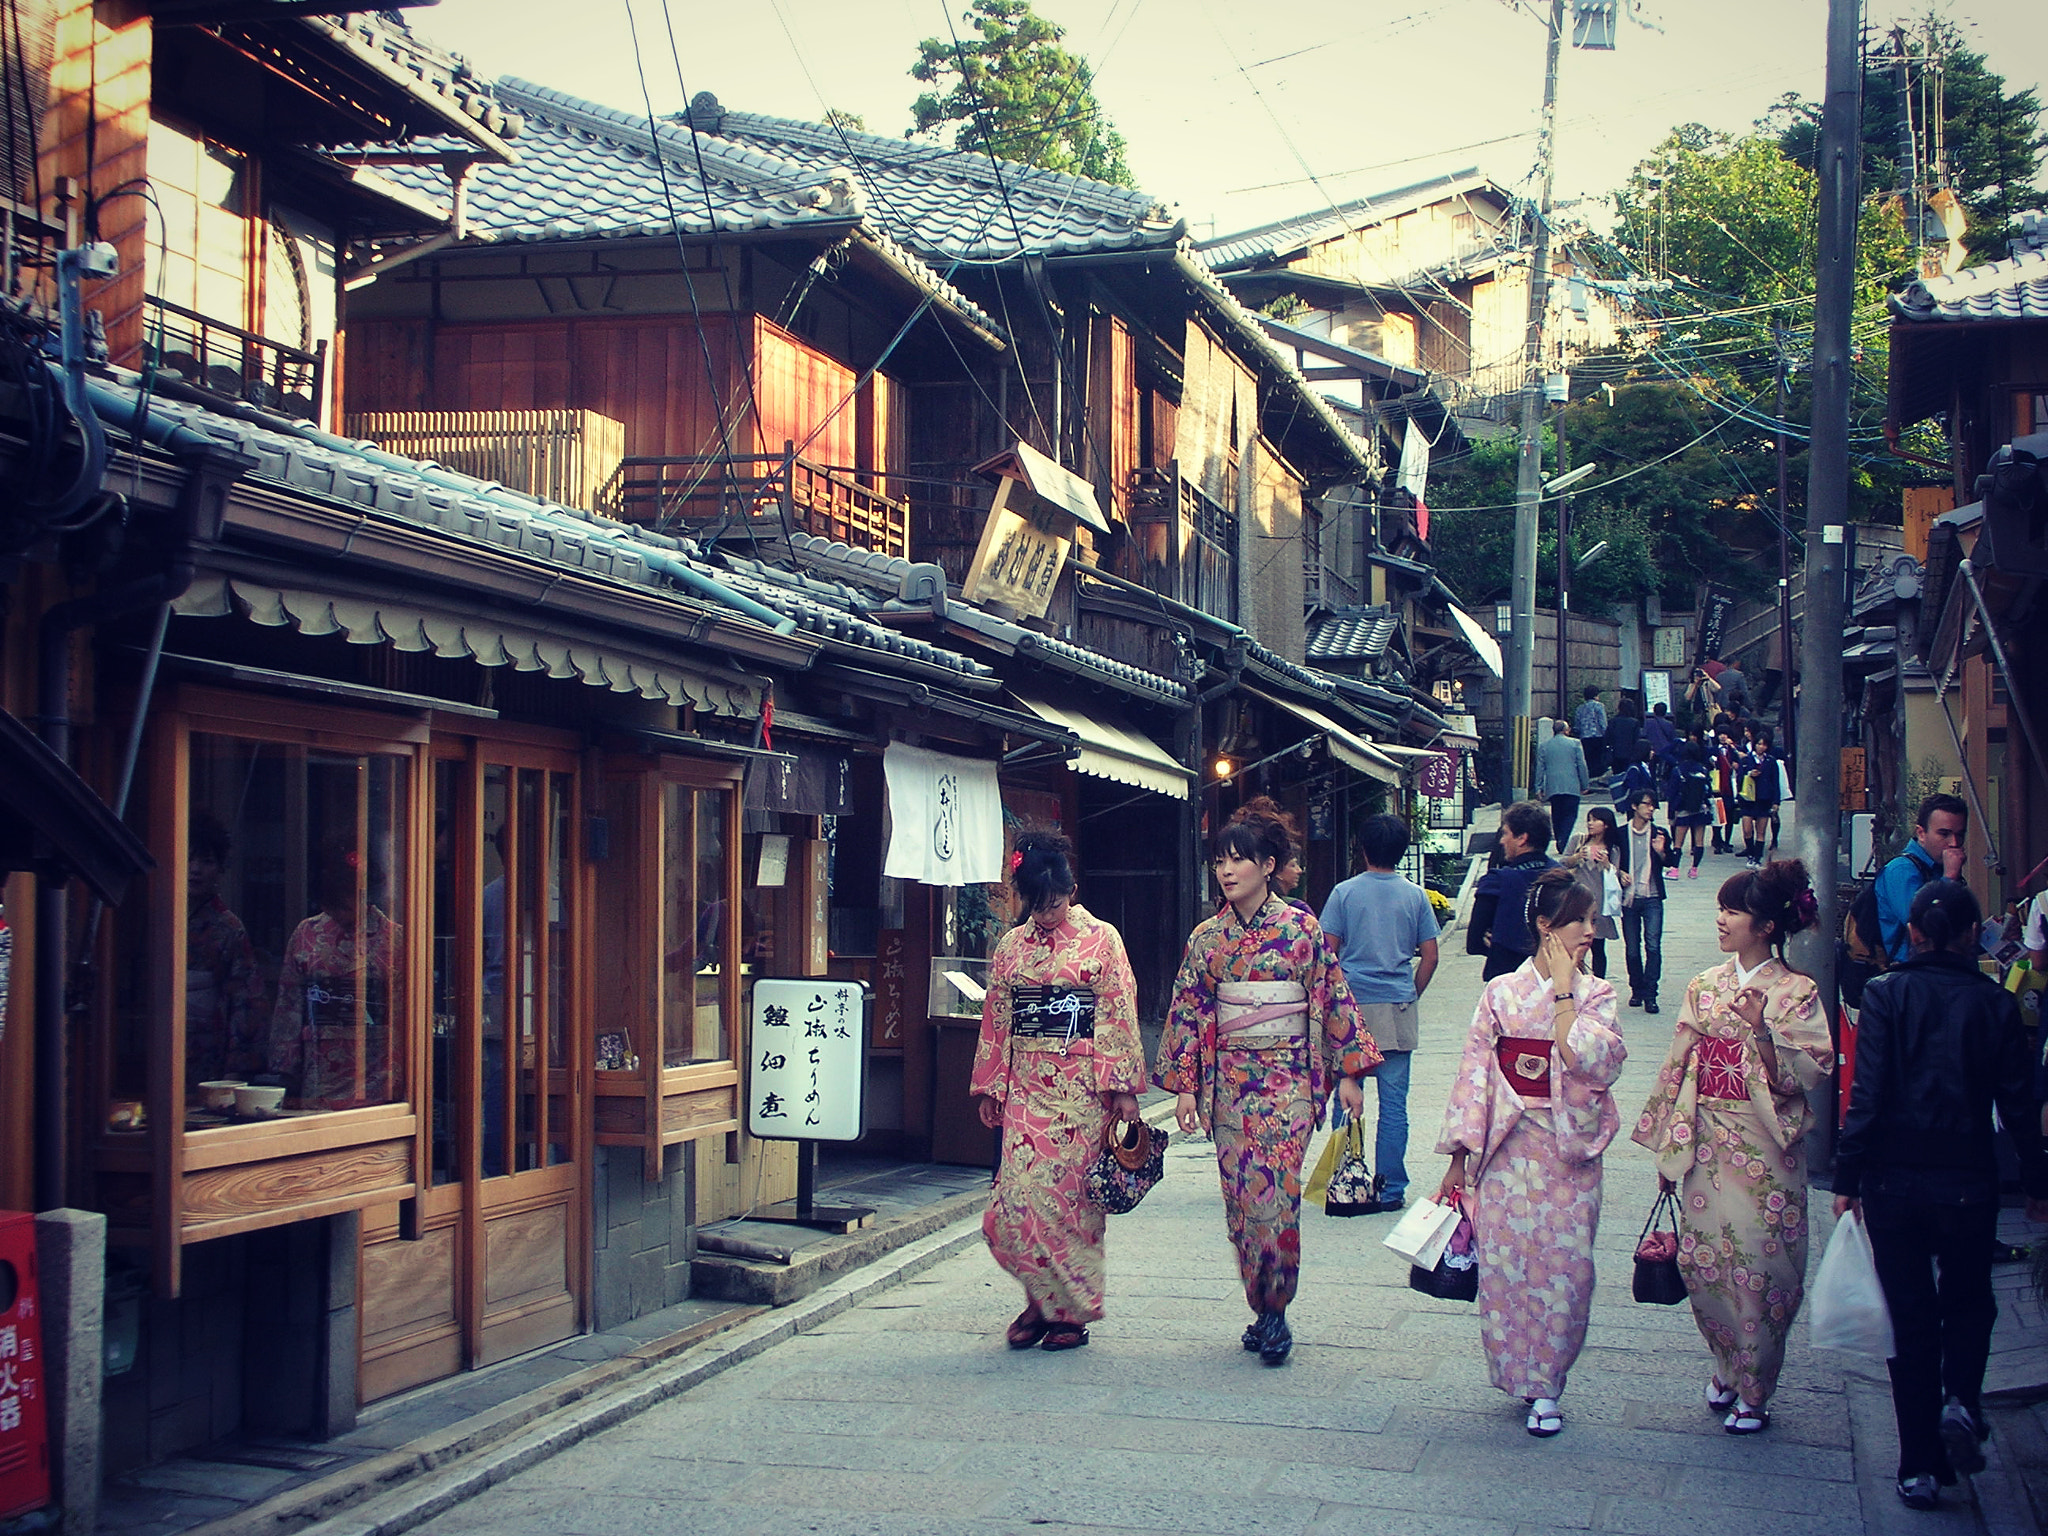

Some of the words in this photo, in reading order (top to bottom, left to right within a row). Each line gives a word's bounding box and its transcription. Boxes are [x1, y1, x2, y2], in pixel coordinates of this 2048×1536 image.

[804, 993, 828, 1126] 山椒ちりめん
